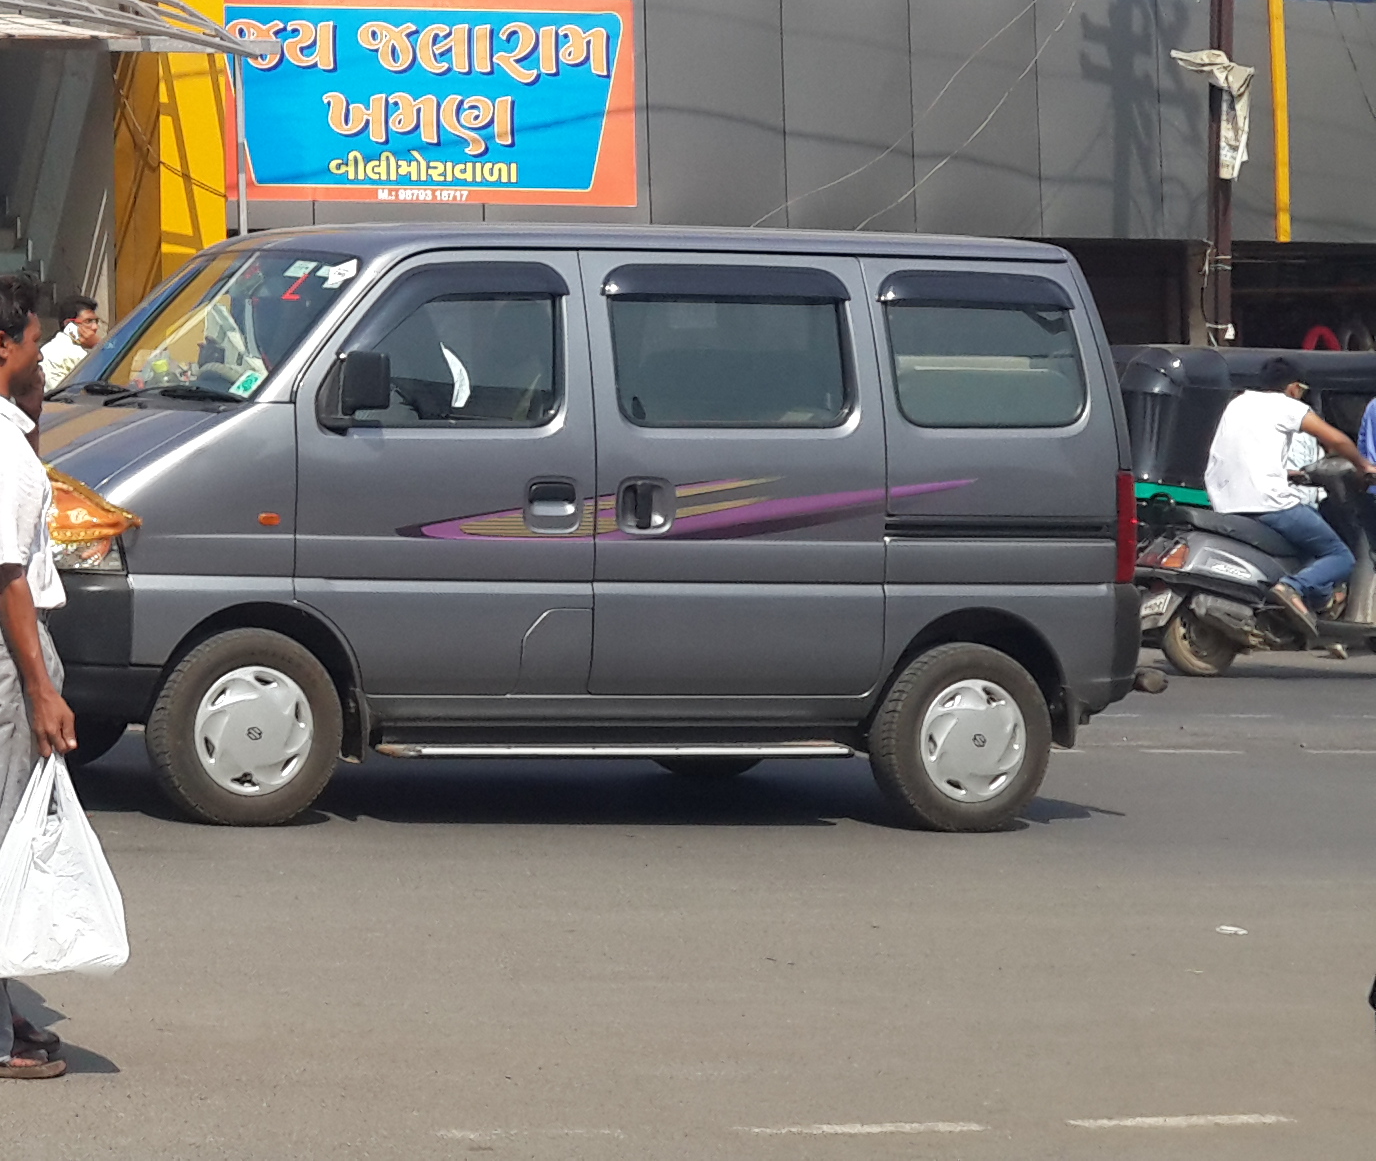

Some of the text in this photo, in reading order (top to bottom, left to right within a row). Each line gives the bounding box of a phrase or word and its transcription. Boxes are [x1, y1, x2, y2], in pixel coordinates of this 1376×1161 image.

[225, 18, 613, 85] જય જલારામ
[322, 91, 517, 157] ખમણ
